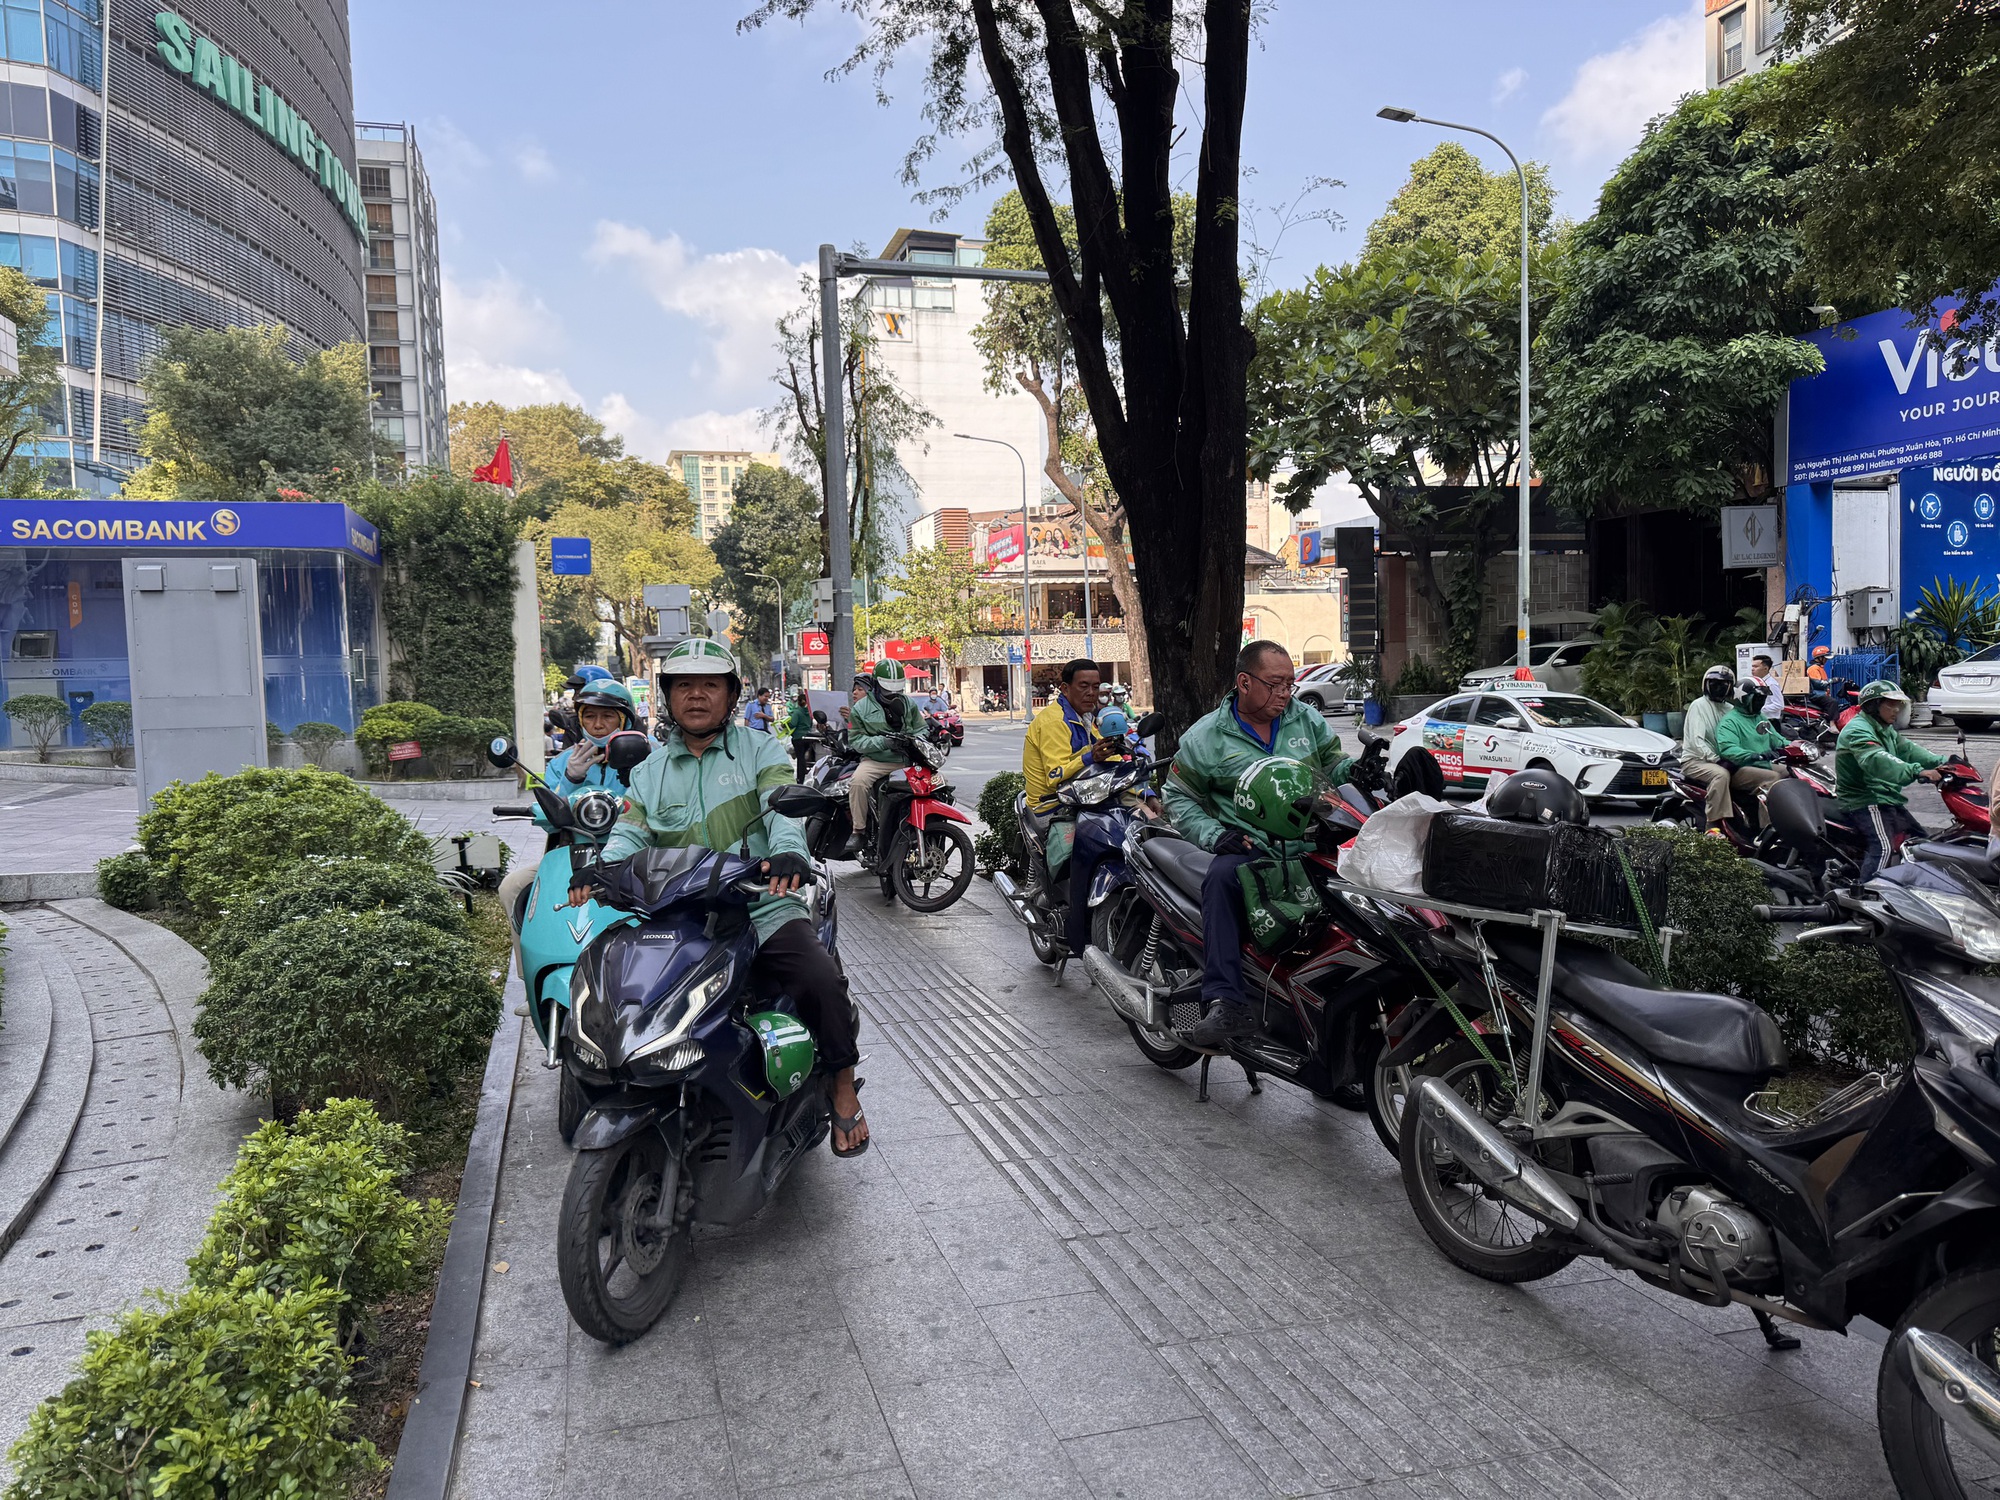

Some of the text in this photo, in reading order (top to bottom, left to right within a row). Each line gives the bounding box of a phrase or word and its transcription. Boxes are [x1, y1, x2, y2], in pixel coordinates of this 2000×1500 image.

[155, 11, 316, 172] SAILING
[1899, 402, 1945, 423] YOUR
[1843, 453, 1859, 463] Minh
[1878, 446, 1904, 455] Phường
[1942, 436, 1954, 445] TP.
[1967, 430, 1980, 440] Chí
[1830, 468, 1838, 476] 38
[1840, 466, 1851, 474] 668
[1852, 463, 1864, 472] 999
[1869, 458, 1896, 469] Hotline:
[1896, 455, 1912, 465] 1800
[1914, 453, 1928, 461] 646
[1928, 450, 1943, 459] 888
[1933, 464, 1978, 481] NGƯỜI
[11, 518, 208, 541] SACOMBANK
[809, 640, 824, 650] 5G
[1479, 754, 1503, 762] VINASUN
